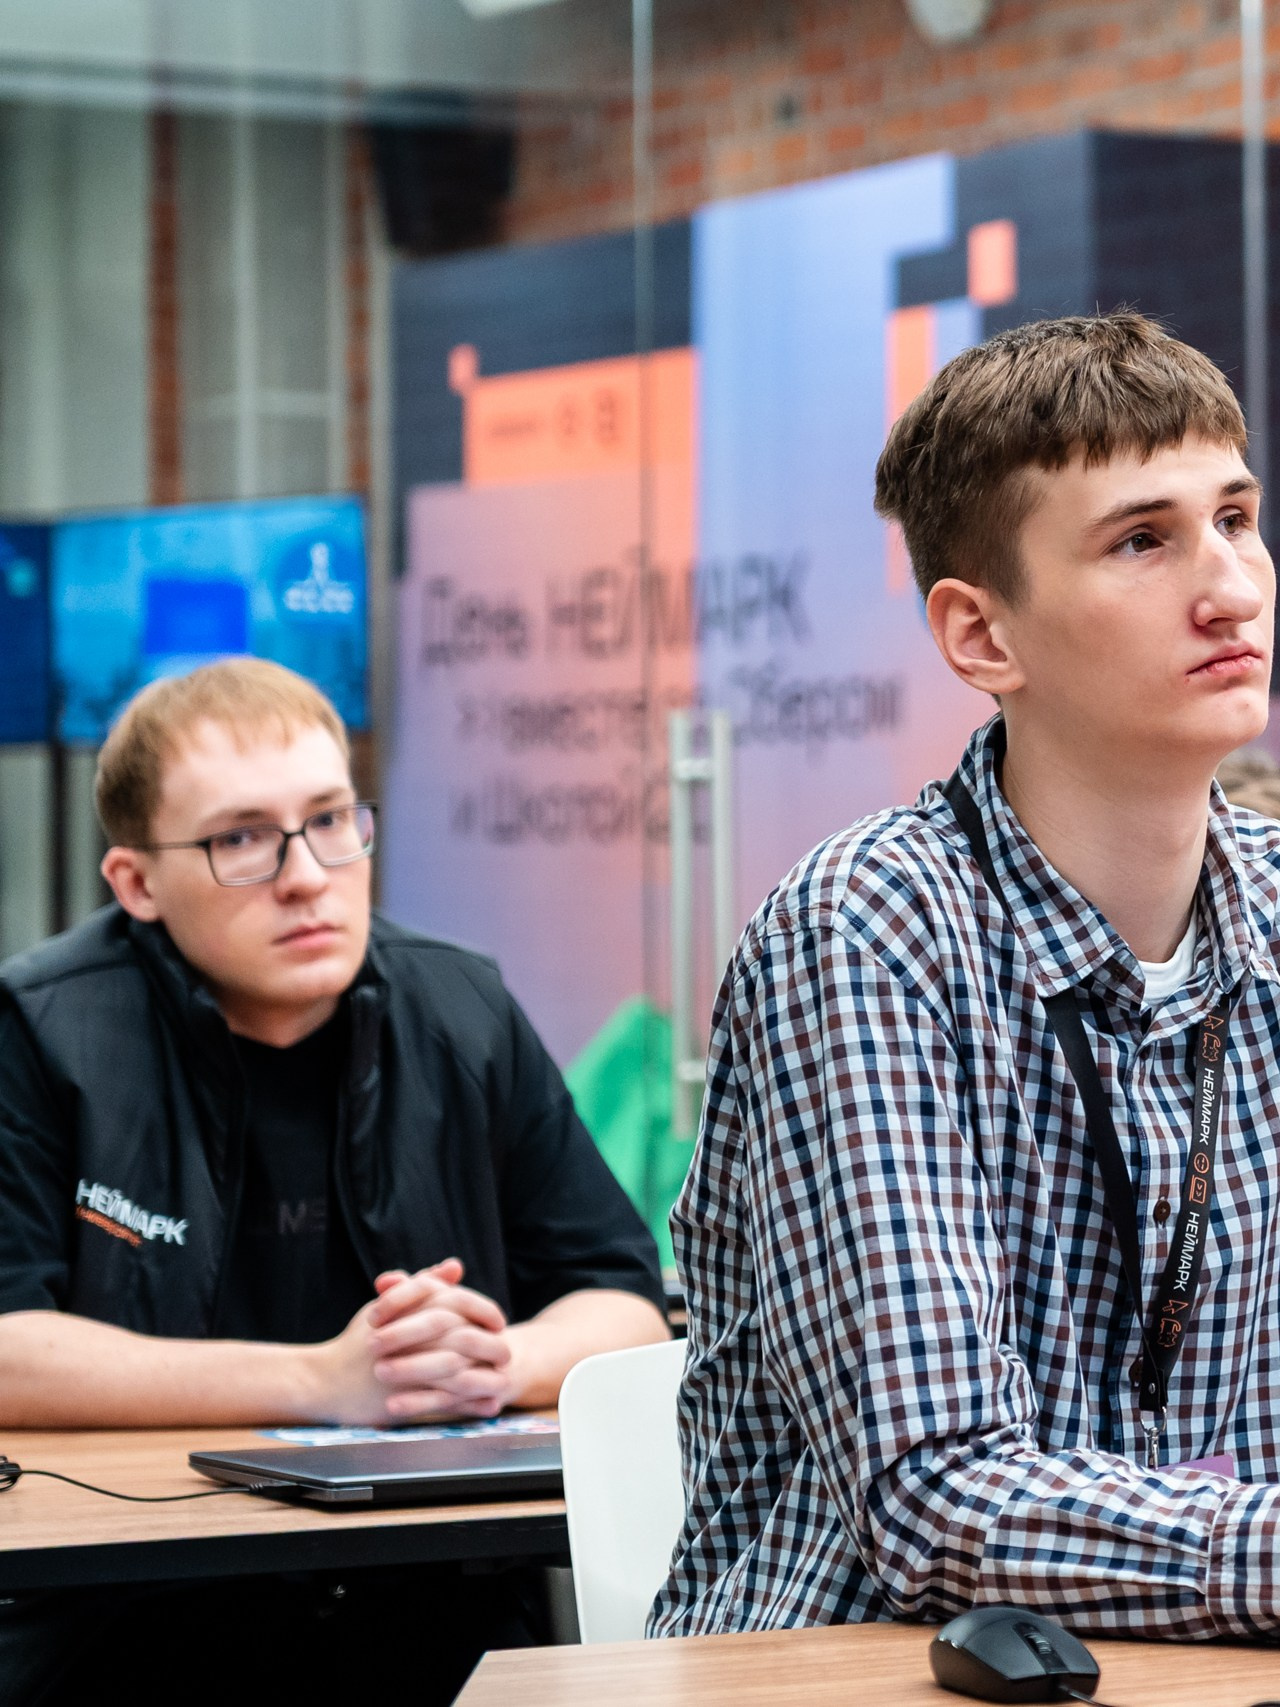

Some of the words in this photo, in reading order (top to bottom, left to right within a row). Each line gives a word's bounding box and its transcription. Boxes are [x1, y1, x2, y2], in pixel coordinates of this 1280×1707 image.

[419, 575, 531, 668] День
[546, 545, 811, 662] НЕЙМАРК
[1199, 1067, 1216, 1146] НЕЙМАРК
[76, 1178, 189, 1246] НЕЙМАРК
[1173, 1211, 1201, 1292] НЕЙМАРК
